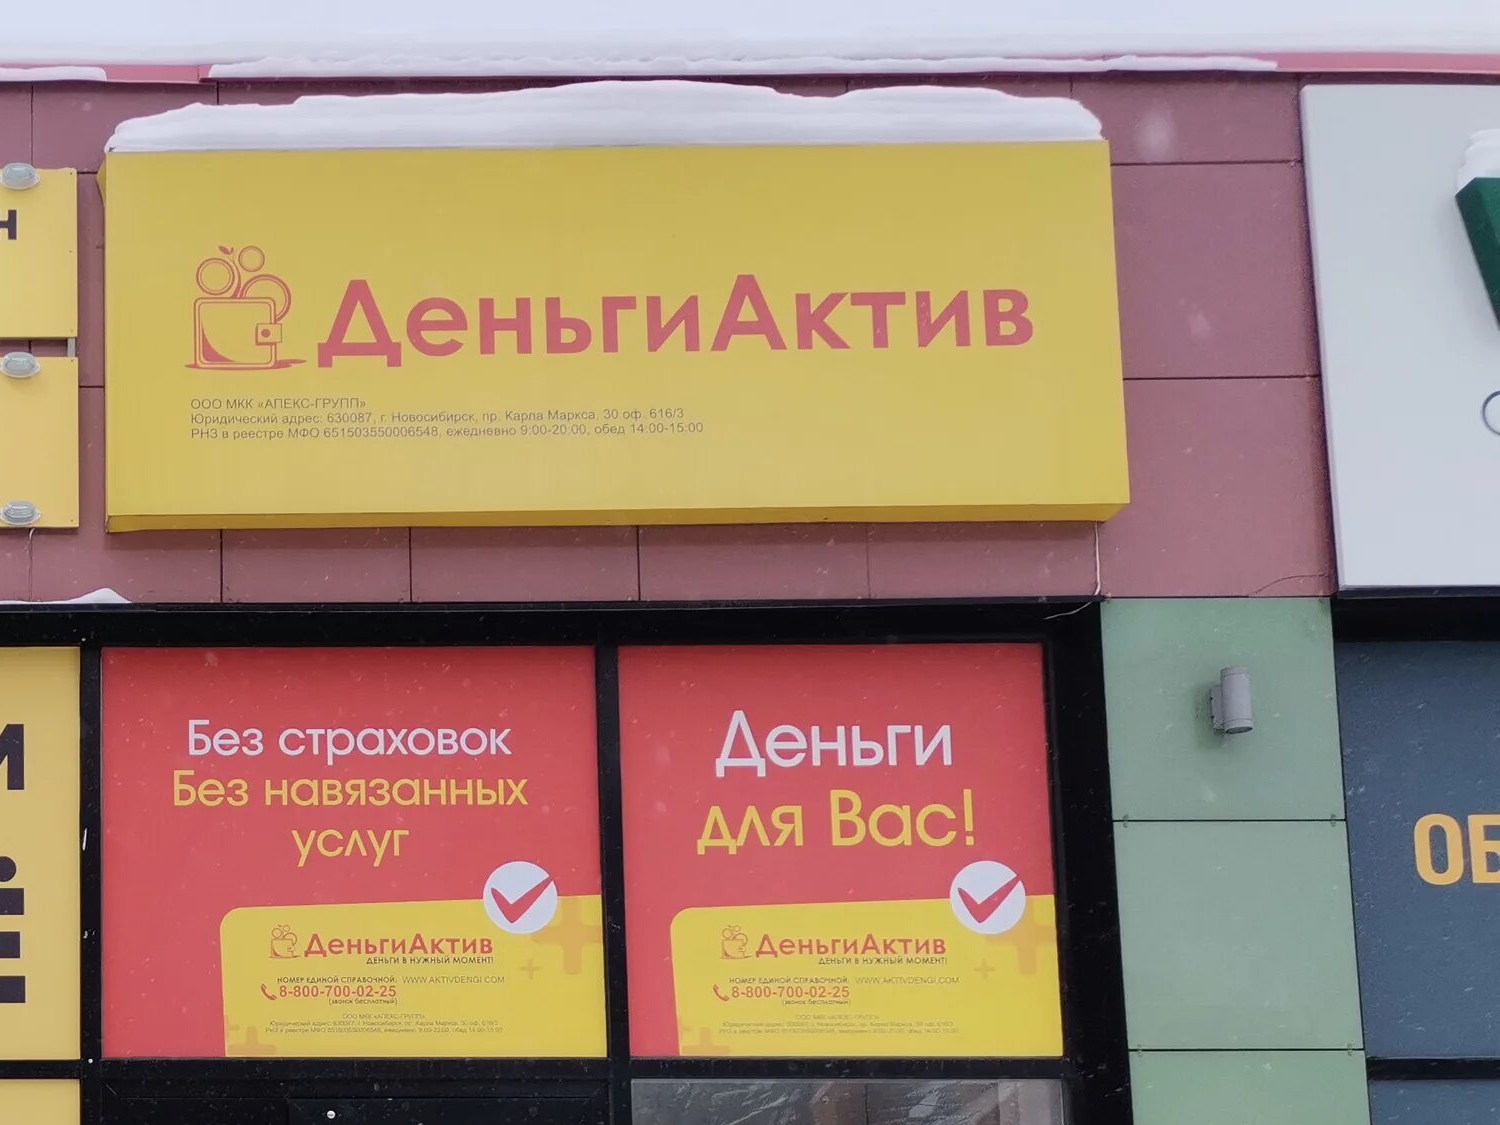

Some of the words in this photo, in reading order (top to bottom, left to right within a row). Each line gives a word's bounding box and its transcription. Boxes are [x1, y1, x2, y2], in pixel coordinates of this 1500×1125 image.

[318, 273, 1034, 369] ДеньгиАктив
[190, 398, 222, 410] ООО
[226, 398, 253, 409] МКК
[257, 397, 366, 410] «АПЕКС-ГРУПП»
[191, 413, 278, 426] Юридический
[282, 413, 323, 426] адрес:
[326, 412, 376, 425] 630087,
[391, 411, 478, 424] Новосибирск,
[505, 410, 543, 423] Карла
[547, 409, 600, 422] Маркса,
[603, 408, 619, 420] 30
[649, 407, 684, 420] 616/3
[191, 428, 219, 439] РНЗ
[233, 429, 284, 441] реестре
[288, 427, 321, 439] МФО
[446, 426, 517, 437] ежедневно
[594, 423, 626, 436] обед
[630, 422, 704, 434] 14:00-15:00
[188, 718, 264, 757] Без
[277, 726, 512, 766] страховок
[715, 709, 953, 778] Деньги
[172, 769, 249, 807] Без
[264, 777, 529, 807] навязанных
[696, 803, 804, 855] для
[829, 787, 976, 847] Вас!
[290, 827, 410, 868] услуг
[303, 932, 494, 958] ДеньгиАктив
[755, 933, 947, 958] ДеньгиАктив
[366, 956, 400, 965] ДЕНЬГИ
[410, 954, 451, 965] НУЖНЫЙ
[453, 956, 494, 964] МОМЕНТ!
[818, 957, 852, 966] ДЕНЬГИ
[862, 955, 903, 965] НУЖНЫЙ
[905, 957, 948, 965] МОМЕНТ!
[277, 976, 304, 984] НОМЕР
[306, 975, 339, 985] ЕДИНОЙ
[729, 976, 756, 984] НОМЕР
[758, 976, 792, 985] ЕДИНОЙ
[278, 985, 398, 998] 8-800-700-02-25
[731, 986, 850, 998] 8-800-700-02-25
